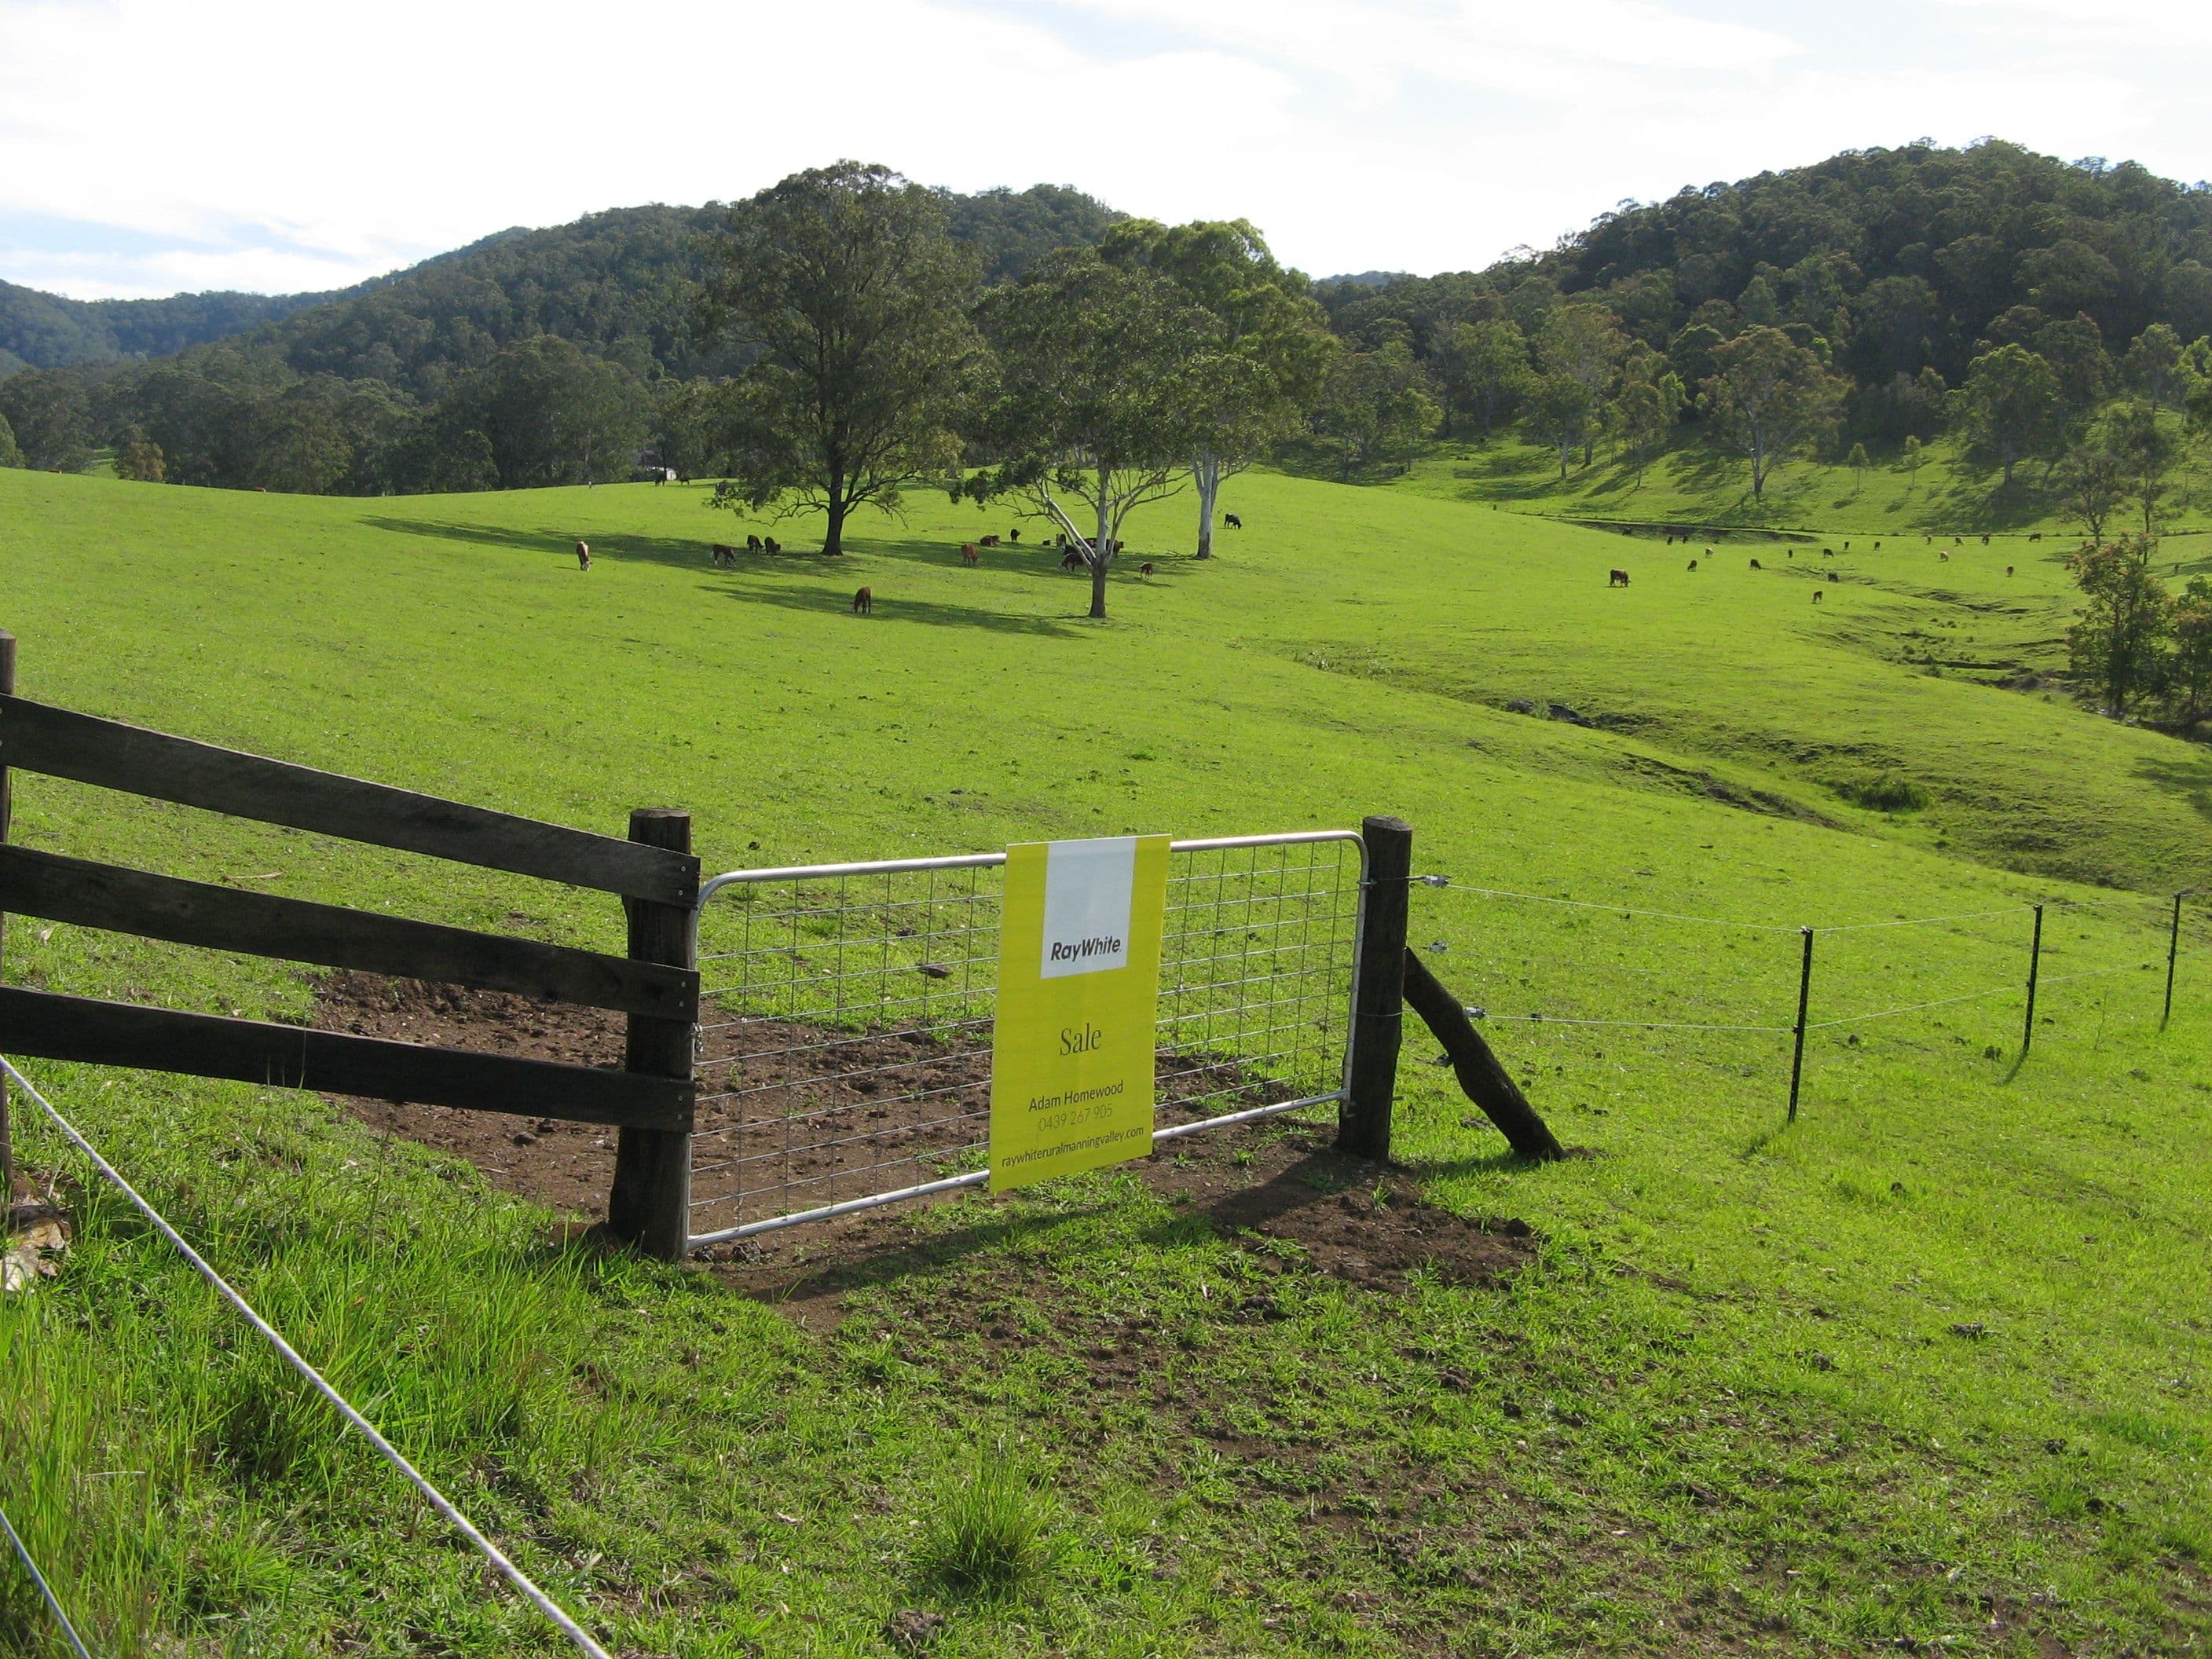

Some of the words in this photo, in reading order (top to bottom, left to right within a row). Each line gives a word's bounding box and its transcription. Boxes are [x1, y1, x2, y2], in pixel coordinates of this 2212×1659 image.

[1059, 1023, 1102, 1057] Sale
[1028, 1095, 1060, 1112] Adam
[1064, 1080, 1124, 1105] Homewood
[1038, 1114, 1068, 1132] 0439
[1070, 1108, 1091, 1126] 267
[1093, 1103, 1113, 1119] 905
[1002, 1126, 1144, 1168] raywhiteruralmanningvalley.com
